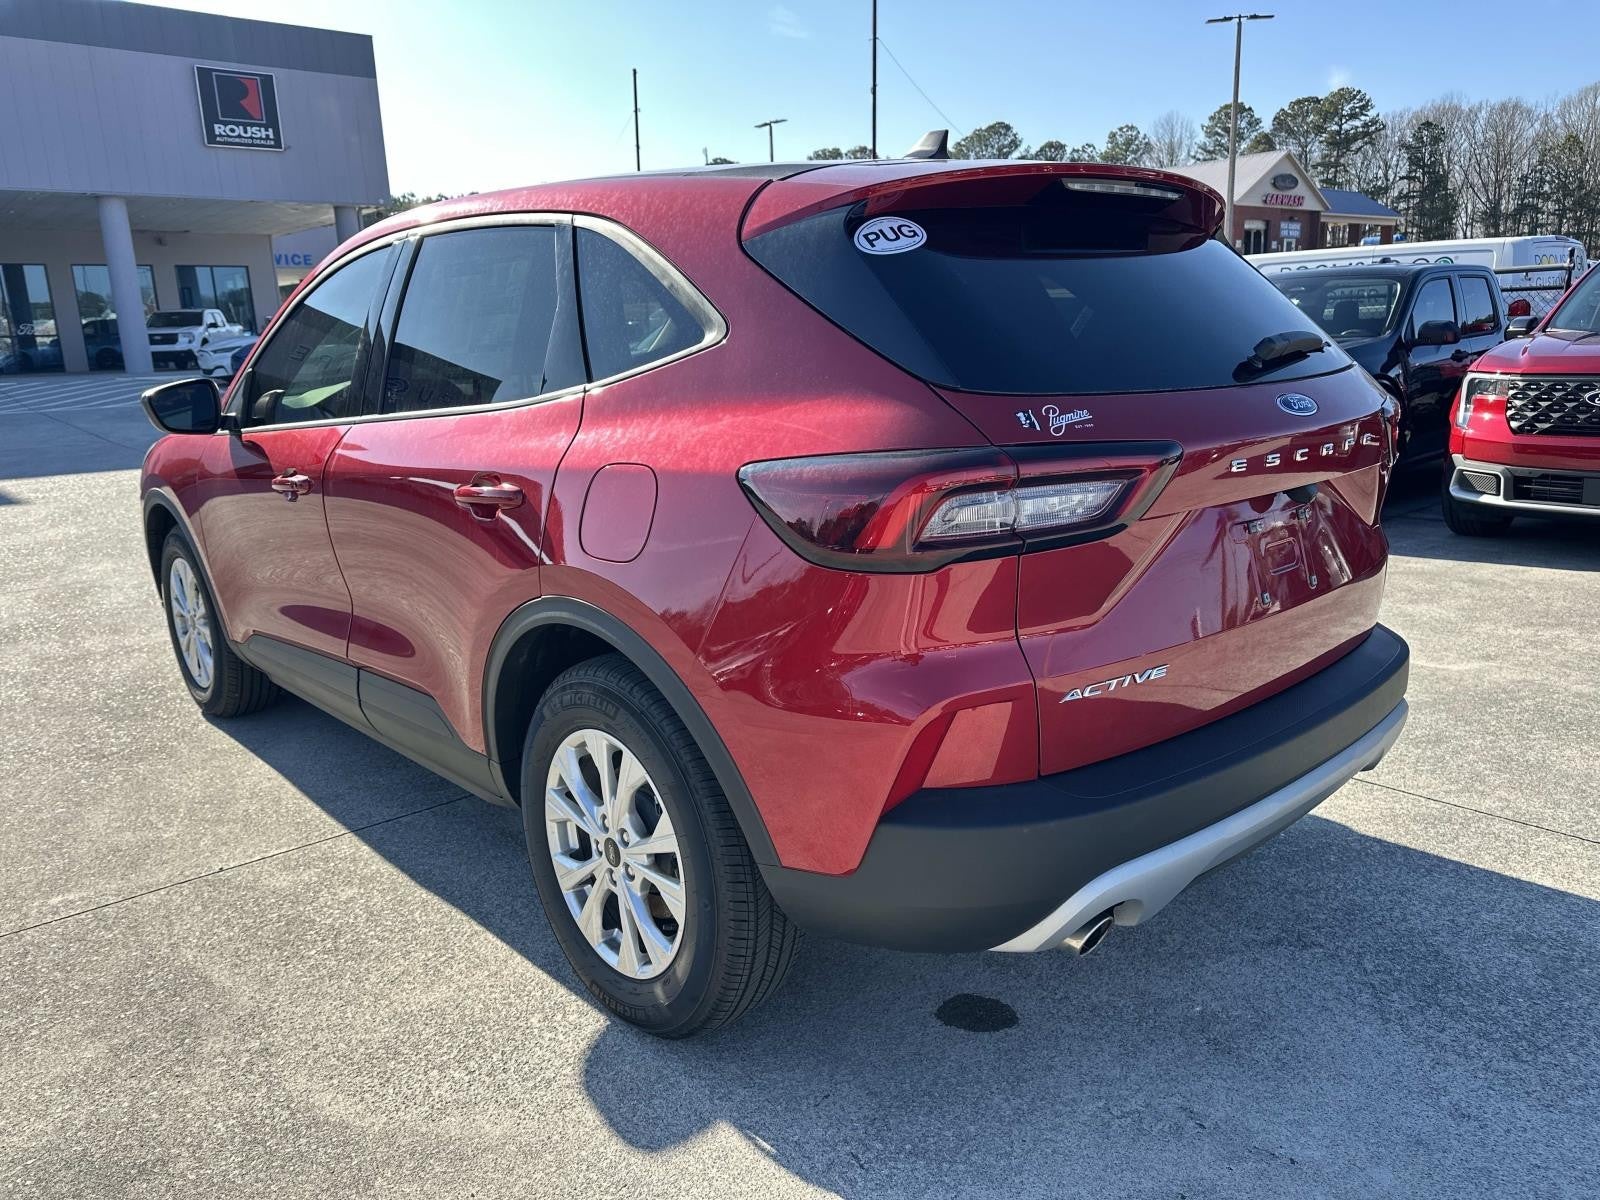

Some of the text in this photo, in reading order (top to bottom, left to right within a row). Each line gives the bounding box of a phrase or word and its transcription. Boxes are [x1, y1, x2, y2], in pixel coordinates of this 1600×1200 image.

[213, 123, 274, 139] ROUSH
[216, 136, 252, 144] AUTHORIZED
[862, 224, 920, 248] PUG
[1042, 404, 1093, 436] Pugmire
[1230, 433, 1380, 472] ESCAPE
[1059, 664, 1170, 704] ACTIVE
